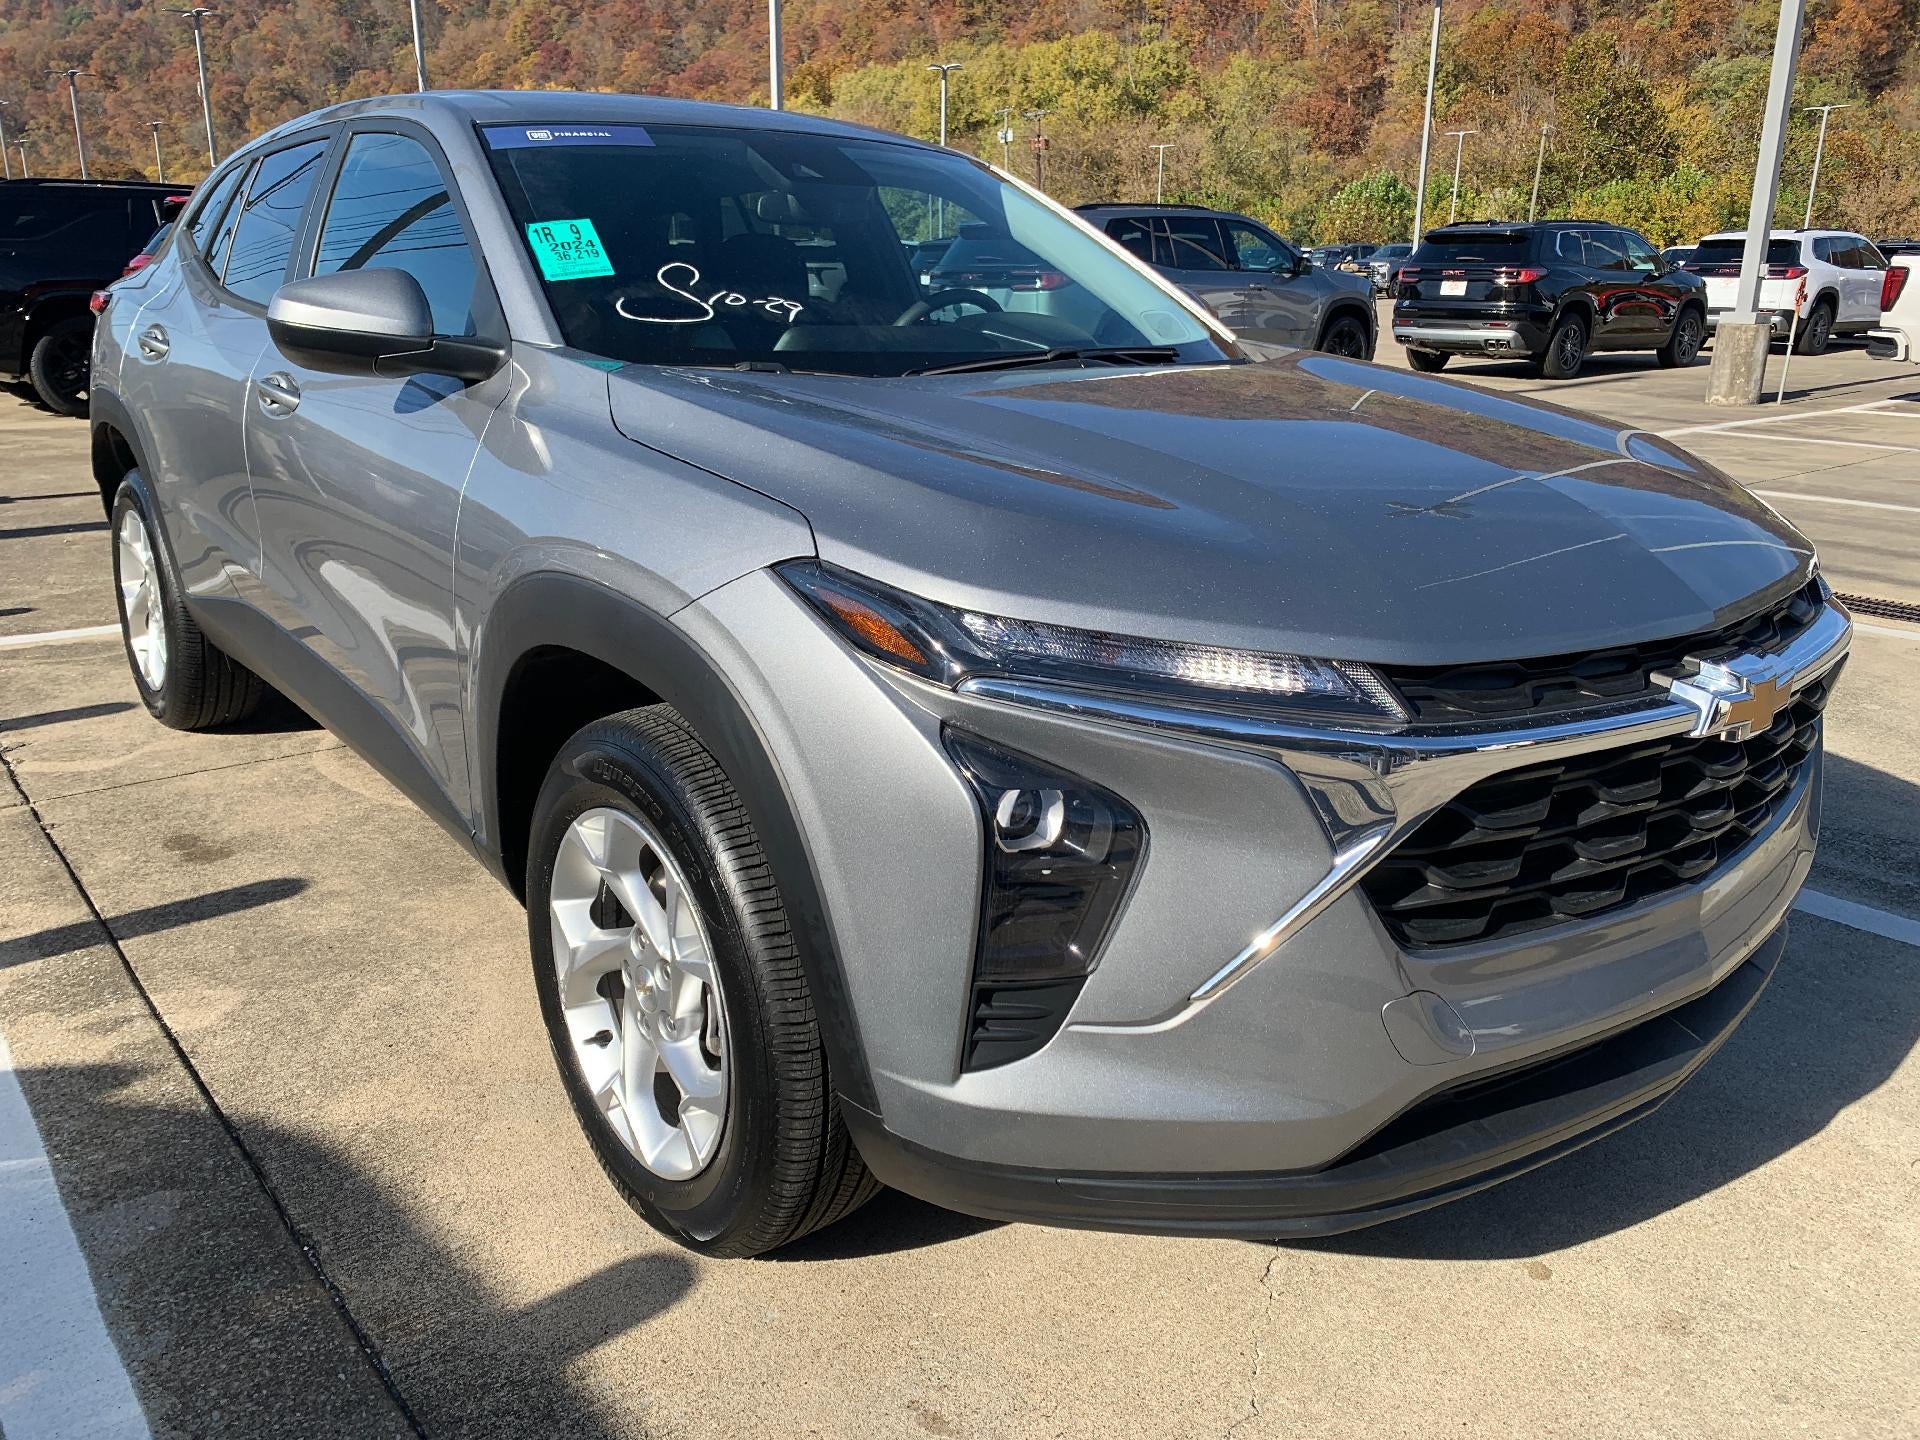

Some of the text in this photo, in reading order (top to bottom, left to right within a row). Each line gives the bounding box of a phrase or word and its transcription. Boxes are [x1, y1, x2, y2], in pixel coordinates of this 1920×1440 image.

[532, 223, 582, 244] 1R 9
[549, 239, 596, 252] 2024
